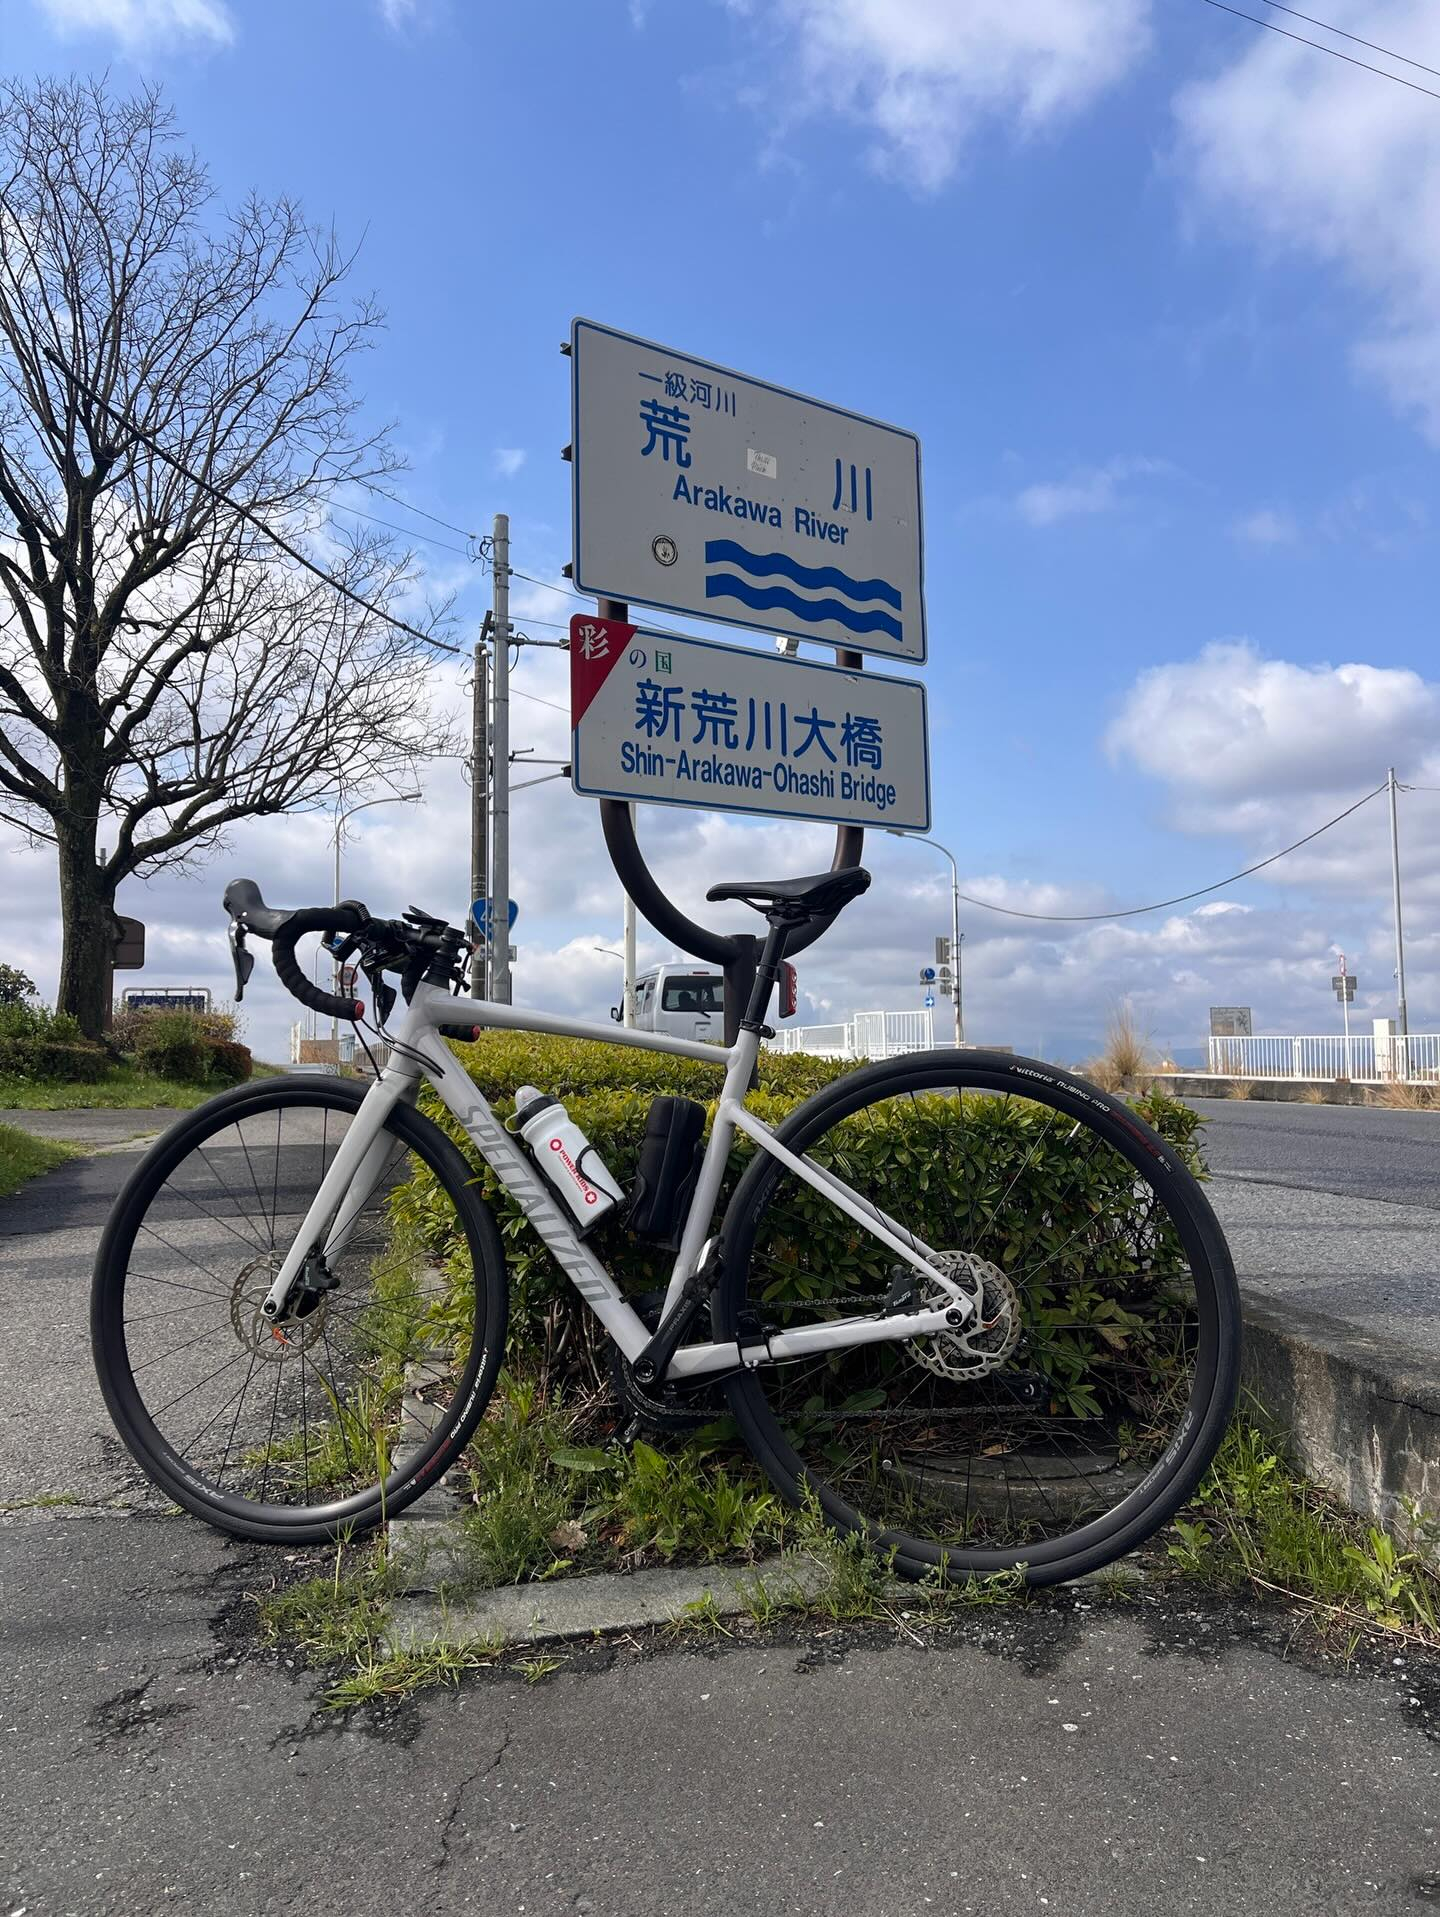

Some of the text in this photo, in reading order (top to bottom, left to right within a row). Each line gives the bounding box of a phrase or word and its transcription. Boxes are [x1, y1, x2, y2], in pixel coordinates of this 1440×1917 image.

[638, 371, 736, 417] 一級河川
[673, 474, 849, 546] Arakawa River
[635, 678, 883, 771] 新荒川大橋
[620, 741, 897, 811] Shin-Arakawa-Ohashi Bridge
[1016, 1066, 1111, 1113] vittoria RUBINO PRO
[460, 1105, 613, 1301] SPECIALIZED
[560, 1149, 578, 1174] POWER
[575, 1173, 590, 1192] KIDS
[450, 1353, 488, 1440] vittoria RUBINO PRO
